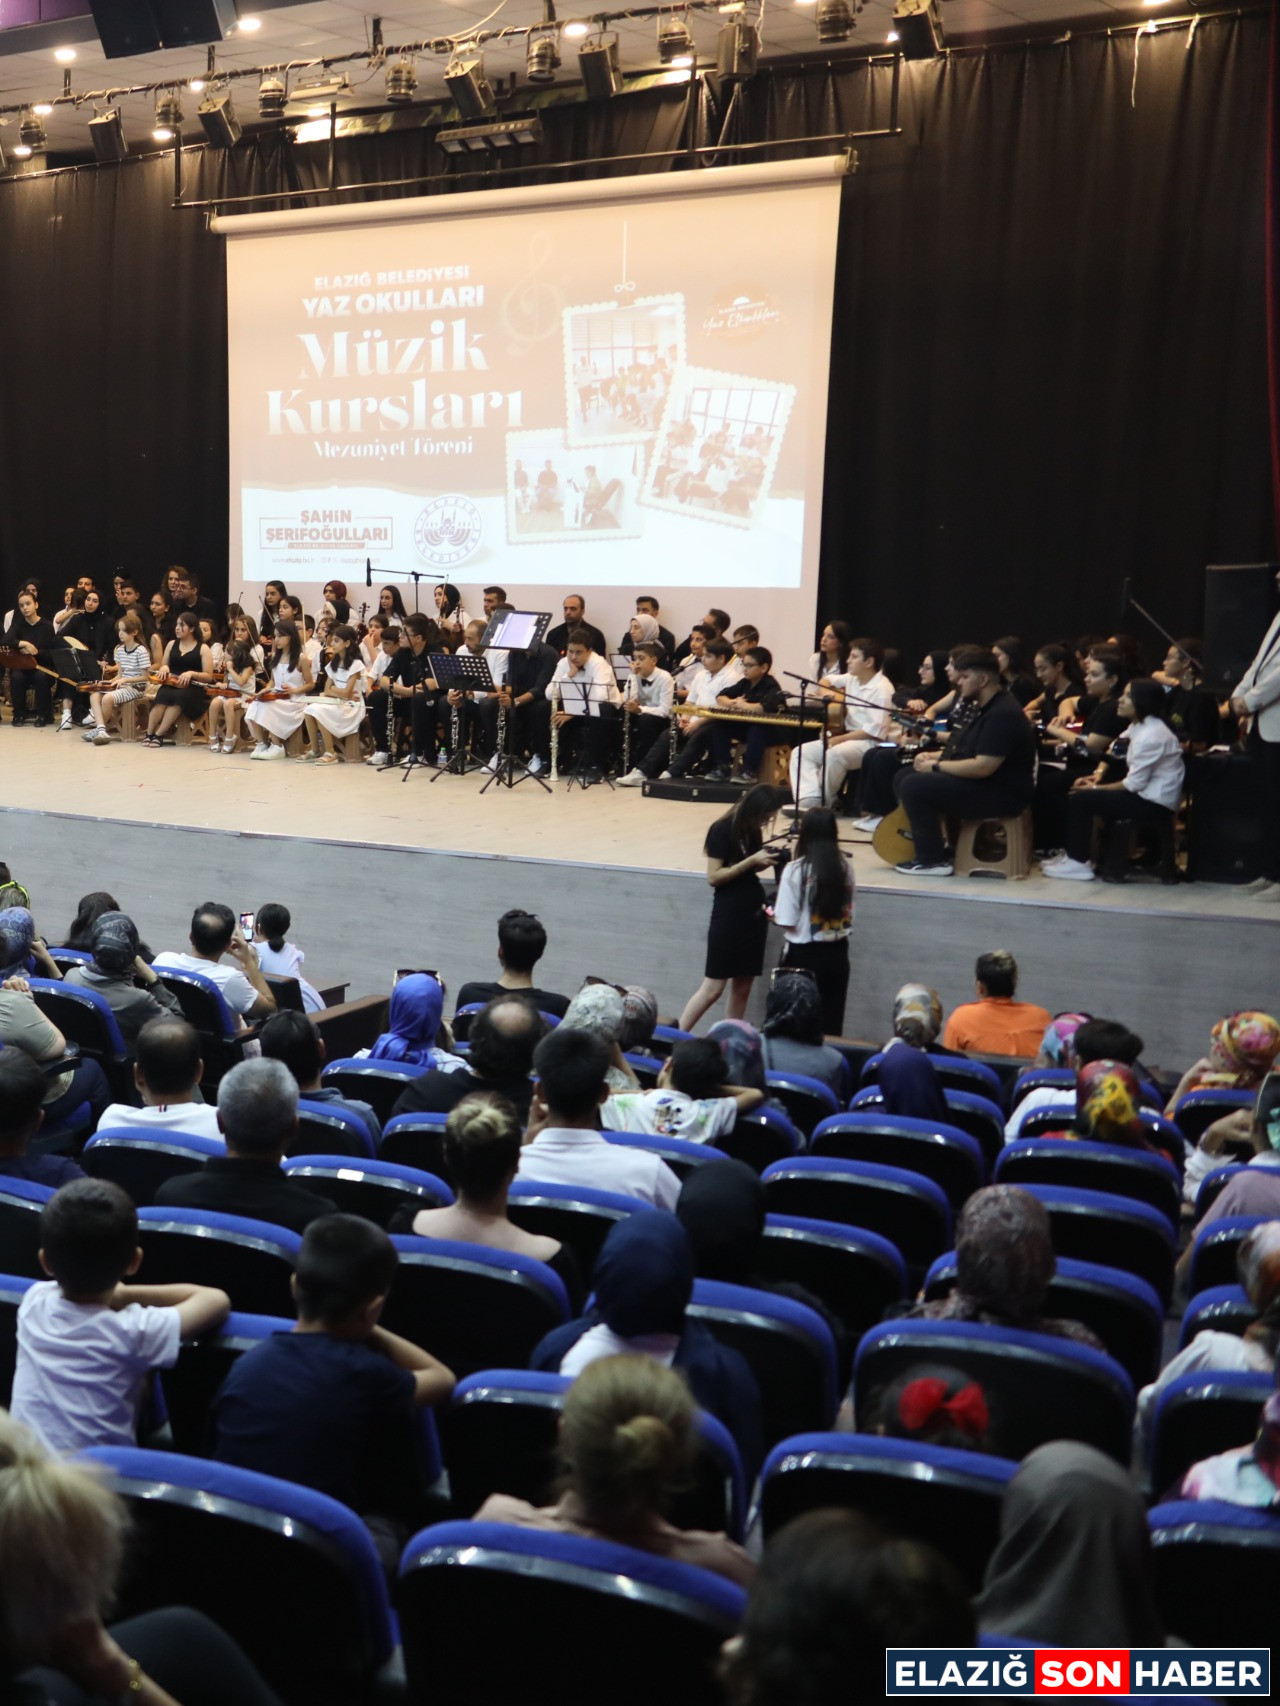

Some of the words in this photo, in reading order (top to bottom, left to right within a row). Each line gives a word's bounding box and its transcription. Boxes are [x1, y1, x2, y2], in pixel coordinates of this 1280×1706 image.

[314, 273, 370, 289] ELAZIĞ
[376, 265, 470, 284] BELEDİYESİ
[303, 296, 351, 318] YAZ
[356, 285, 484, 314] OKULLARI
[297, 318, 490, 379] Müzik
[266, 378, 523, 435] Kursları
[313, 438, 406, 461] Mezuniyet
[410, 435, 474, 456] Töreni
[300, 509, 352, 525] ŞAHİN
[266, 525, 388, 543] ŞERİFOĞULLARI
